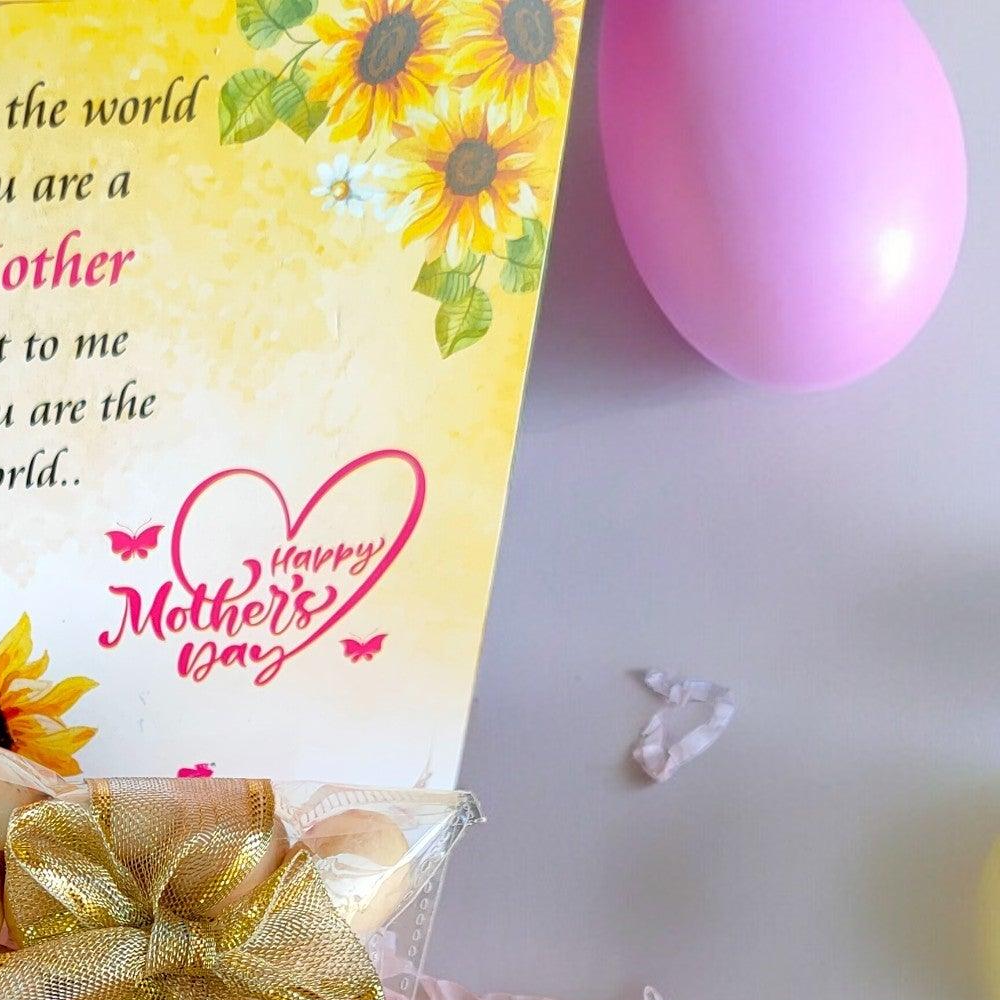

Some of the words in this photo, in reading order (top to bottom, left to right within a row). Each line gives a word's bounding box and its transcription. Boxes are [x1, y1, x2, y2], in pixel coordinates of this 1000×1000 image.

[6, 81, 67, 130] the
[84, 75, 209, 128] world
[32, 171, 93, 202] are
[107, 171, 131, 200] a
[24, 334, 59, 364] to
[74, 330, 129, 360] me
[29, 397, 87, 428] are
[101, 379, 157, 421] the
[270, 537, 386, 576] Happy
[98, 559, 338, 649] Mother's
[177, 640, 292, 687] Day
